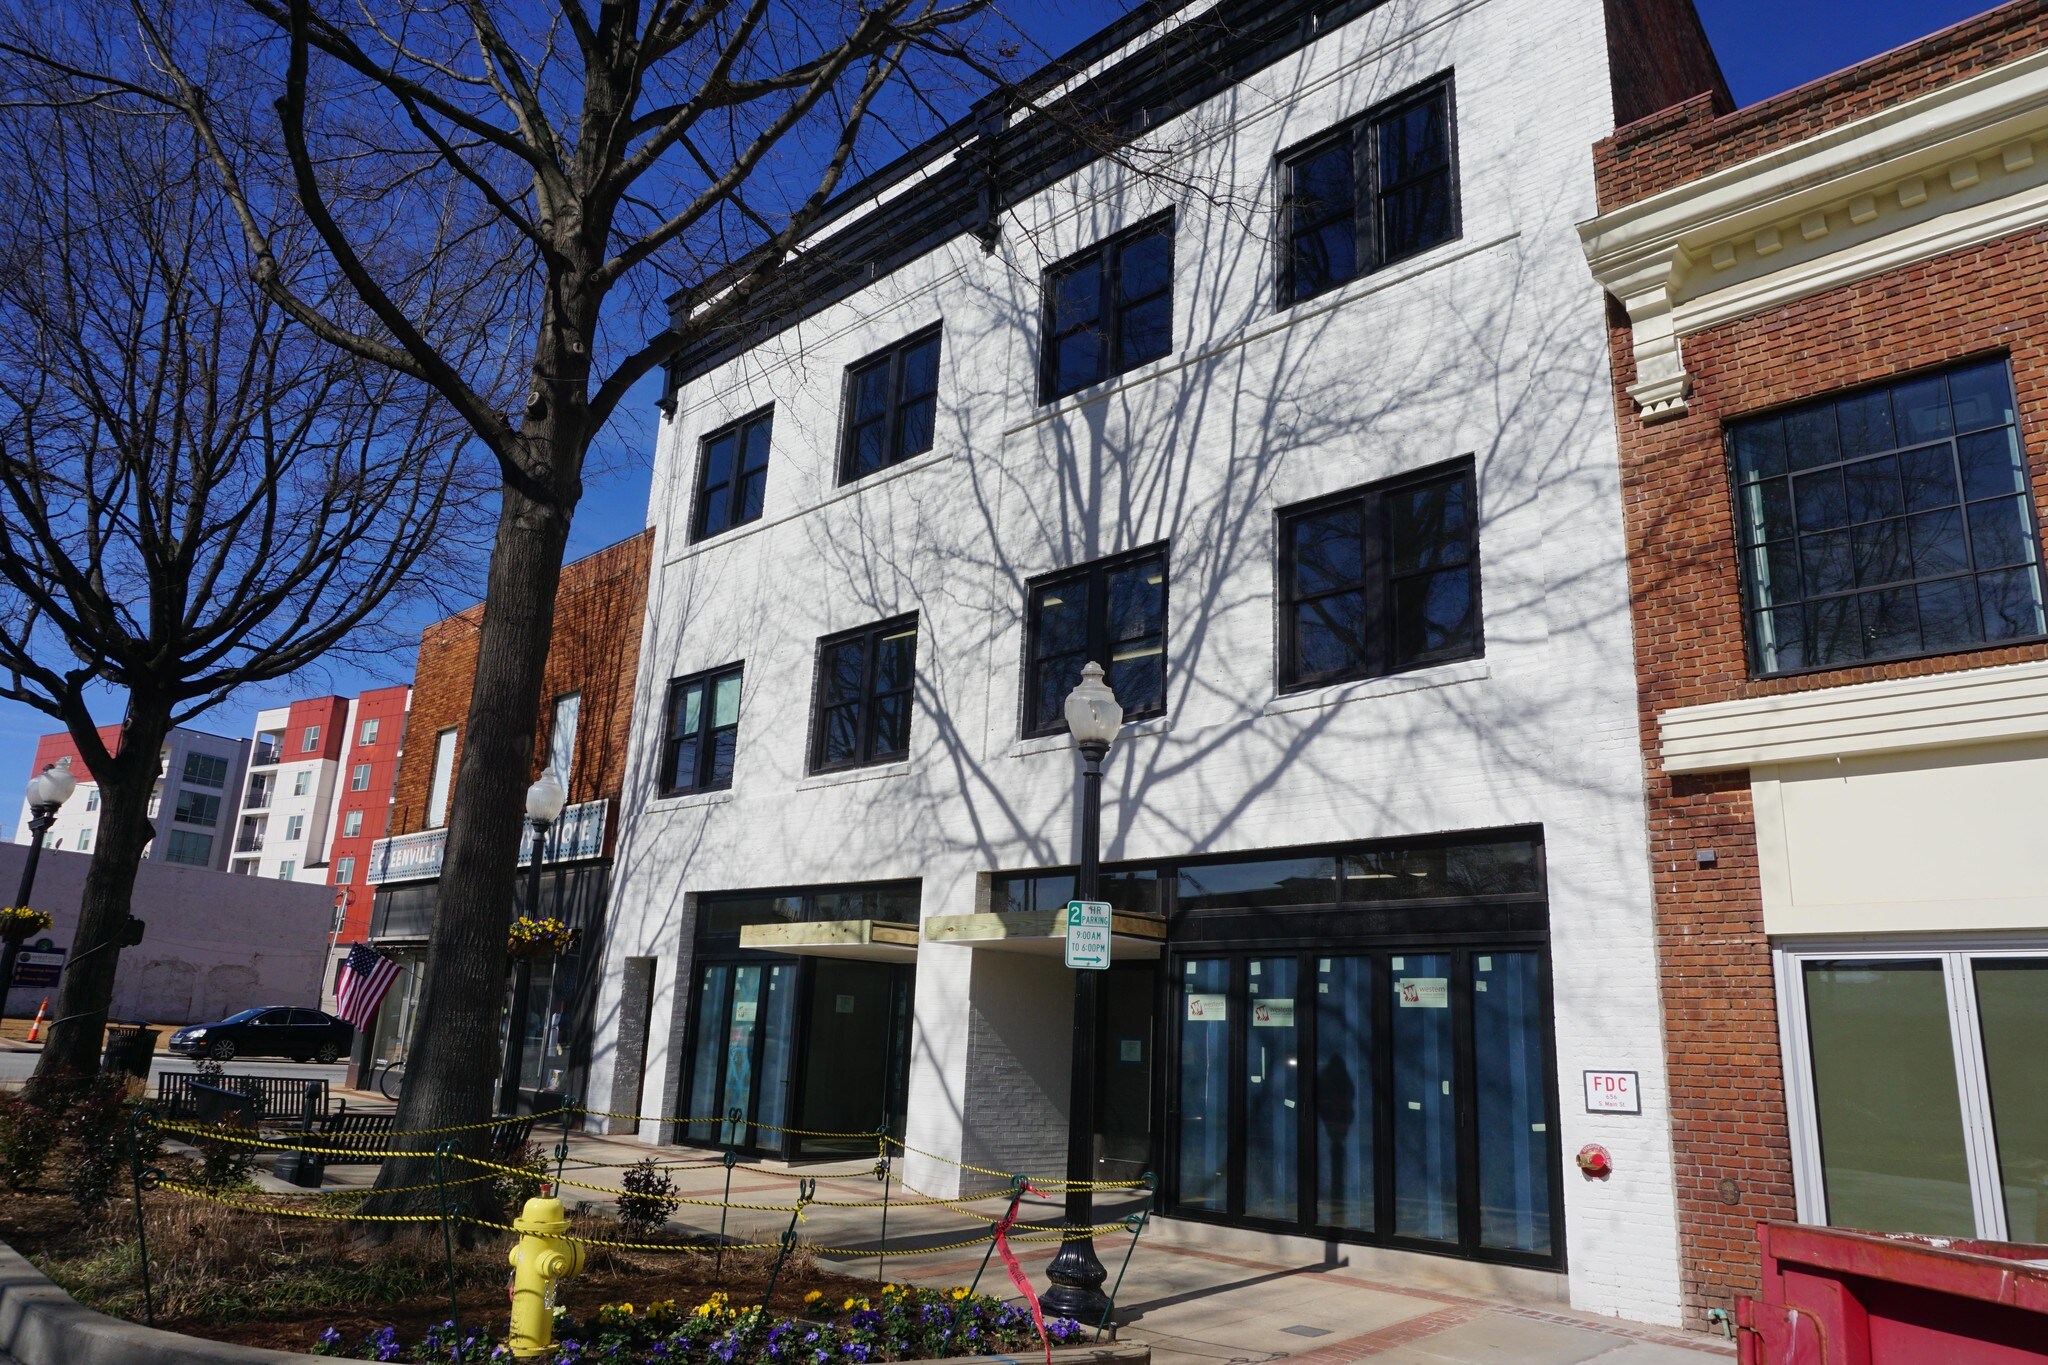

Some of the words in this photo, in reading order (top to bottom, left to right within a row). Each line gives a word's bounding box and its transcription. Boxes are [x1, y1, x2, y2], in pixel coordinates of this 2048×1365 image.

[1070, 906, 1080, 923] 2
[1090, 906, 1102, 914] HR
[1082, 915, 1109, 925] PARKING
[1072, 943, 1080, 952] TO
[1082, 943, 1105, 953] 6:00PM
[1593, 1076, 1627, 1092] FDC
